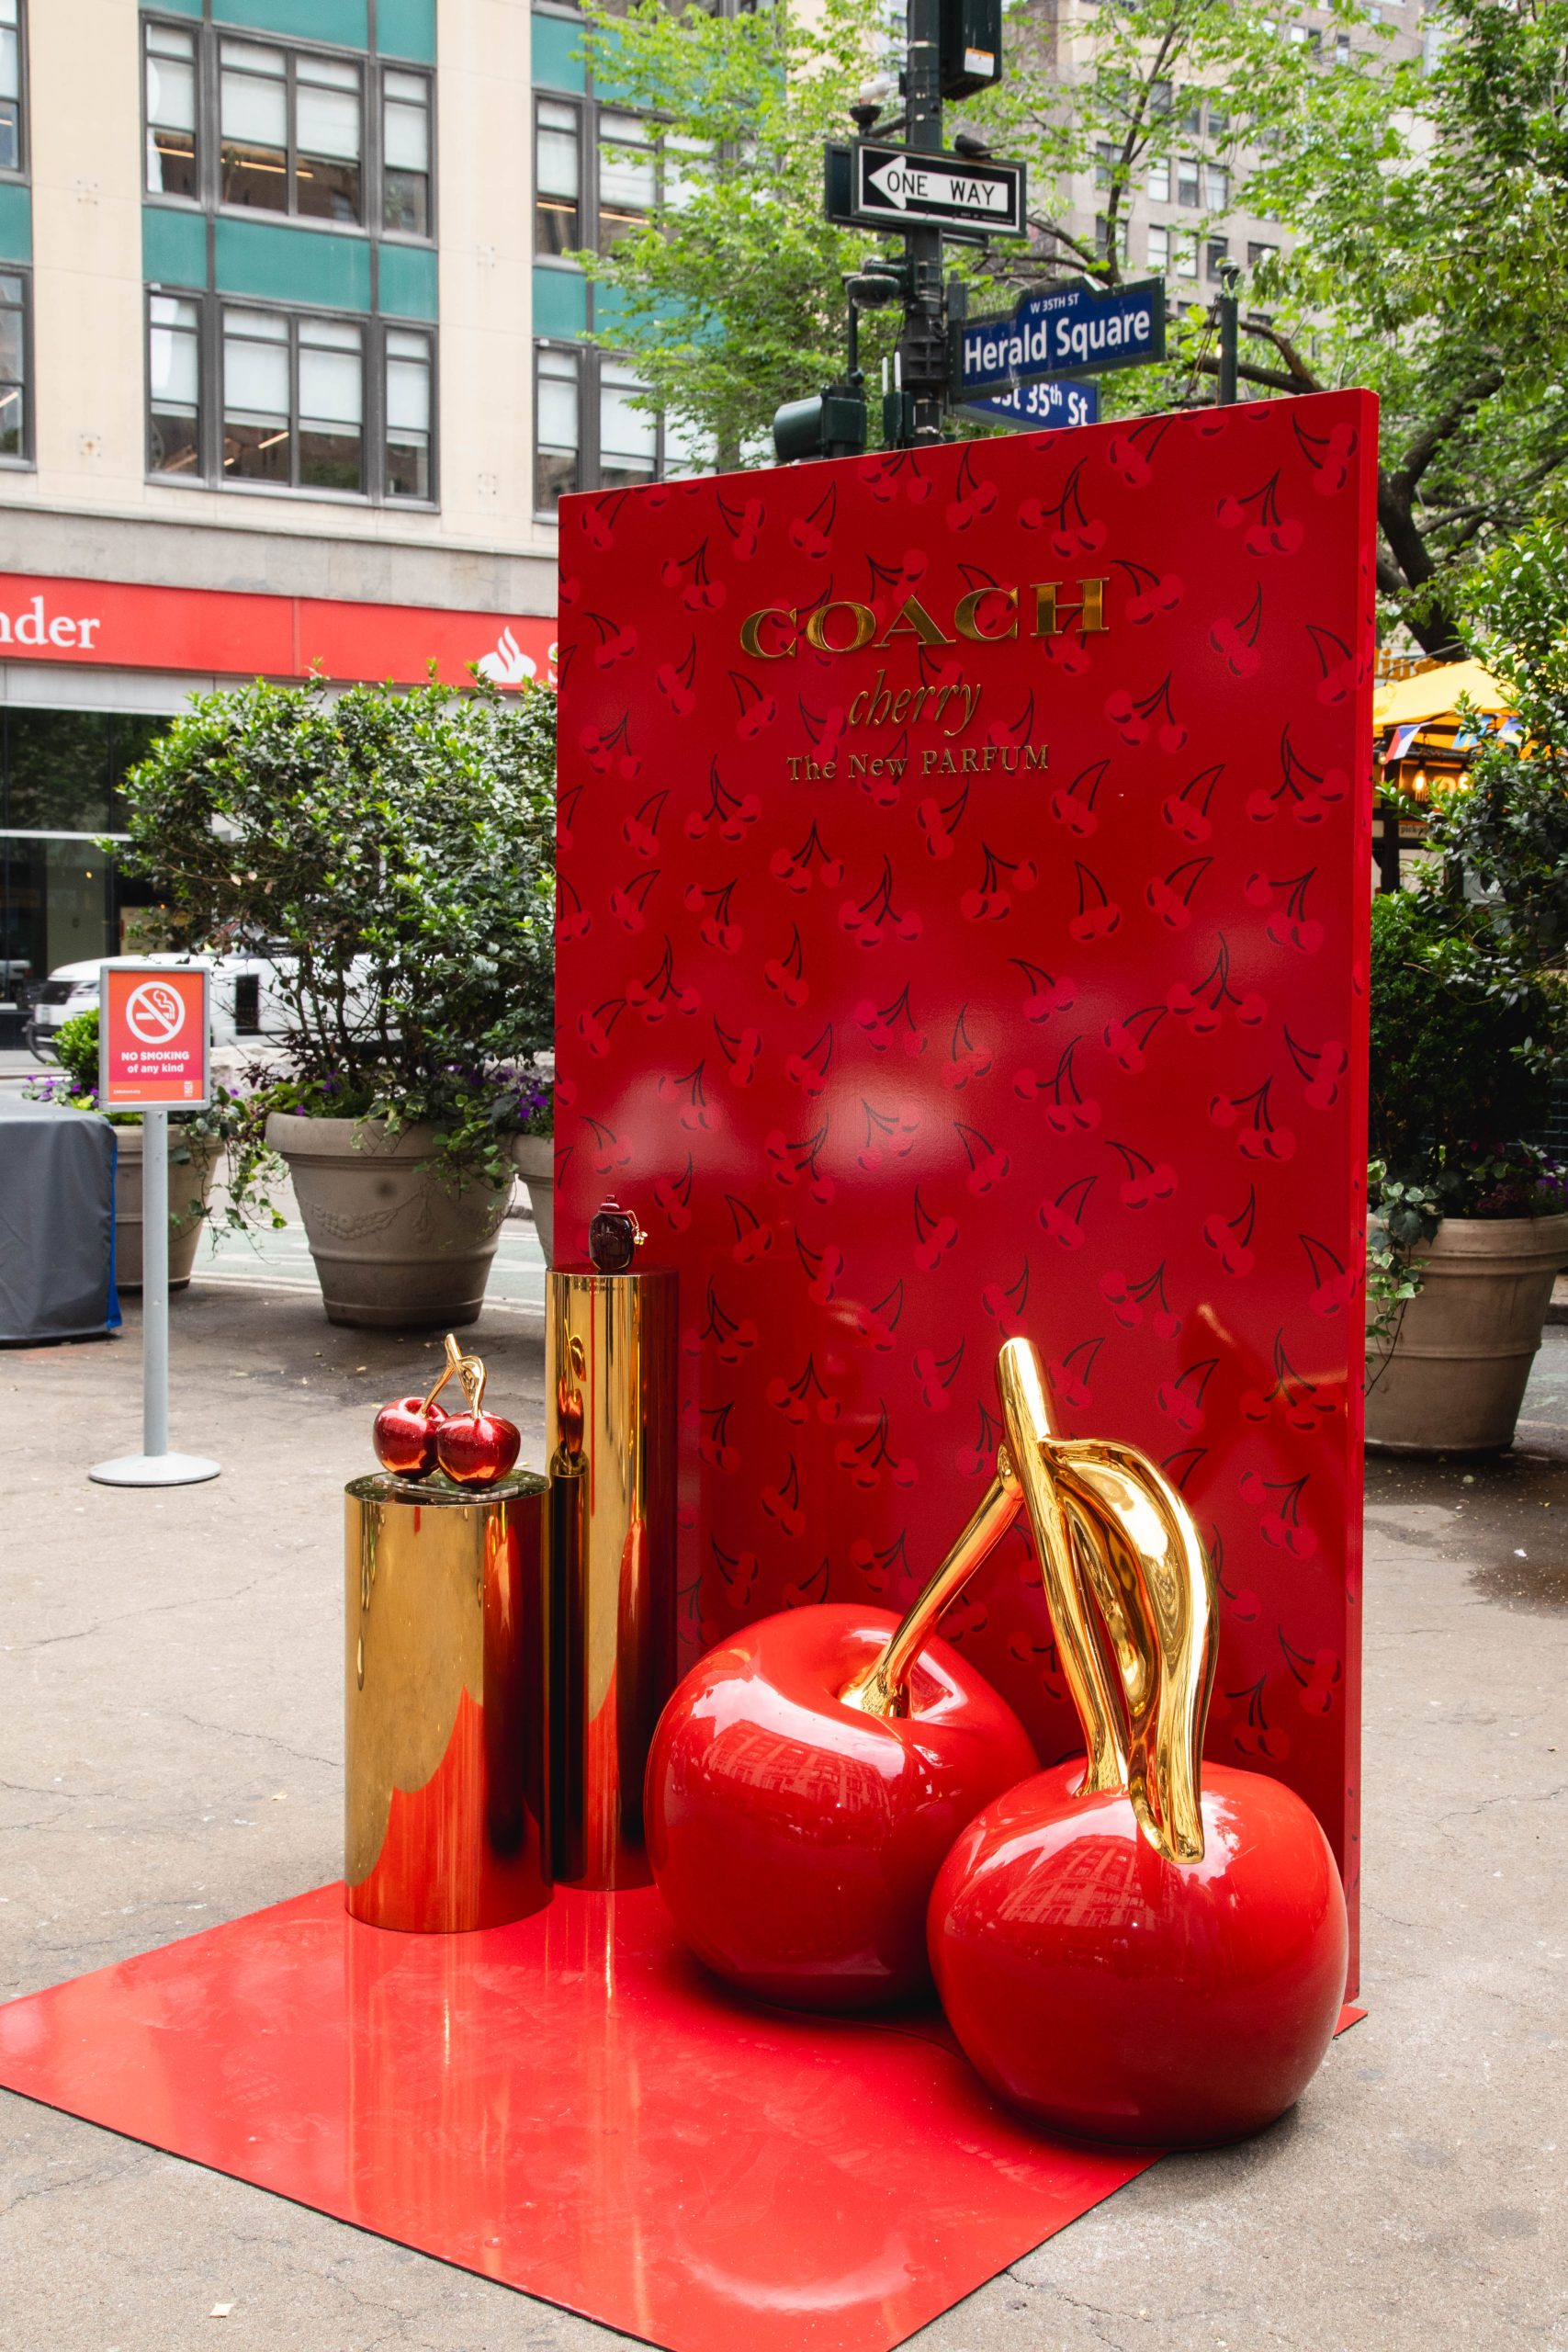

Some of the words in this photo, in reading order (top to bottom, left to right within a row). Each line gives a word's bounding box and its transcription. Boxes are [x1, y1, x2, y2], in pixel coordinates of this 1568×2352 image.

[886, 170, 929, 198] ONE
[950, 178, 996, 206] WAY
[1030, 300, 1041, 315] W
[1042, 295, 1066, 312] 35TH
[1067, 292, 1080, 308] ST
[964, 319, 1047, 375] Herald
[1056, 309, 1150, 362] Square
[1026, 382, 1063, 417] 35th
[1067, 391, 1089, 426] St
[739, 576, 1111, 661] COACH
[848, 668, 983, 737] cherry
[785, 753, 838, 782] The
[847, 752, 909, 780] New
[920, 744, 1050, 775] PARFUM
[120, 1051, 139, 1061] NO
[140, 1051, 190, 1060] SMOKING
[127, 1063, 139, 1073] of
[141, 1064, 159, 1074] any
[162, 1063, 184, 1072] kind
